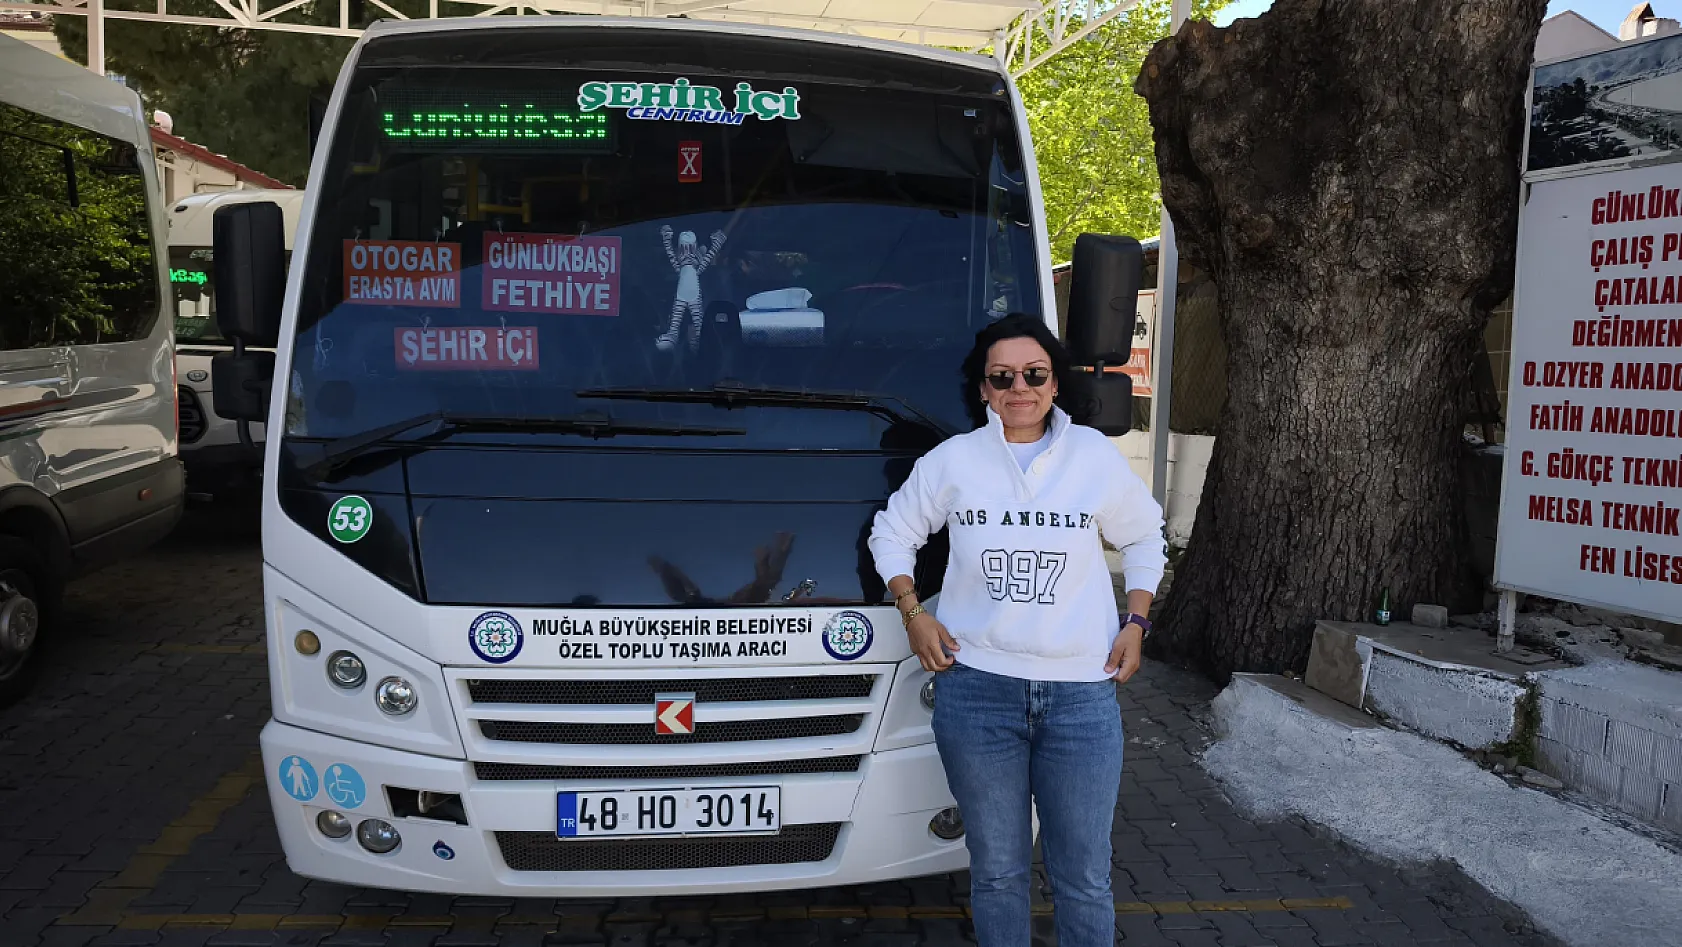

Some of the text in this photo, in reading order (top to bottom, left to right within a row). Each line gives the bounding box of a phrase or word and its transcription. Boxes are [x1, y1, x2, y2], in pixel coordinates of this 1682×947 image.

[577, 76, 725, 112] ŞEHİR
[626, 107, 746, 126] CENTRUM
[1591, 185, 1682, 225] GÜNLÜK
[350, 245, 453, 271] OTOGAR
[489, 237, 616, 280] GÜNLÜKBAŞI
[1590, 233, 1682, 272] ÇALIŞ P
[350, 275, 456, 301] ERASTA AVM
[492, 275, 610, 310] FETHİYE
[1594, 275, 1682, 312] ÇATALA
[1523, 361, 1604, 389] O.OZYER
[1529, 400, 1583, 432] FATİH
[1521, 450, 1539, 476] G.
[1547, 447, 1614, 486] GÖKÇE
[333, 506, 367, 531] 53
[1528, 495, 1680, 536] MELSA TEKNİK
[1580, 544, 1616, 574] FEN
[981, 549, 1067, 605] 997
[532, 615, 594, 636] MUĞLA
[599, 616, 711, 639] BÜYÜKŞEHİR
[716, 614, 812, 636] BELEDİYESİ
[559, 639, 787, 661] ÖZEL TOPLU TAŞIMA ARACI
[561, 792, 775, 831] TR 48 HO 3014
